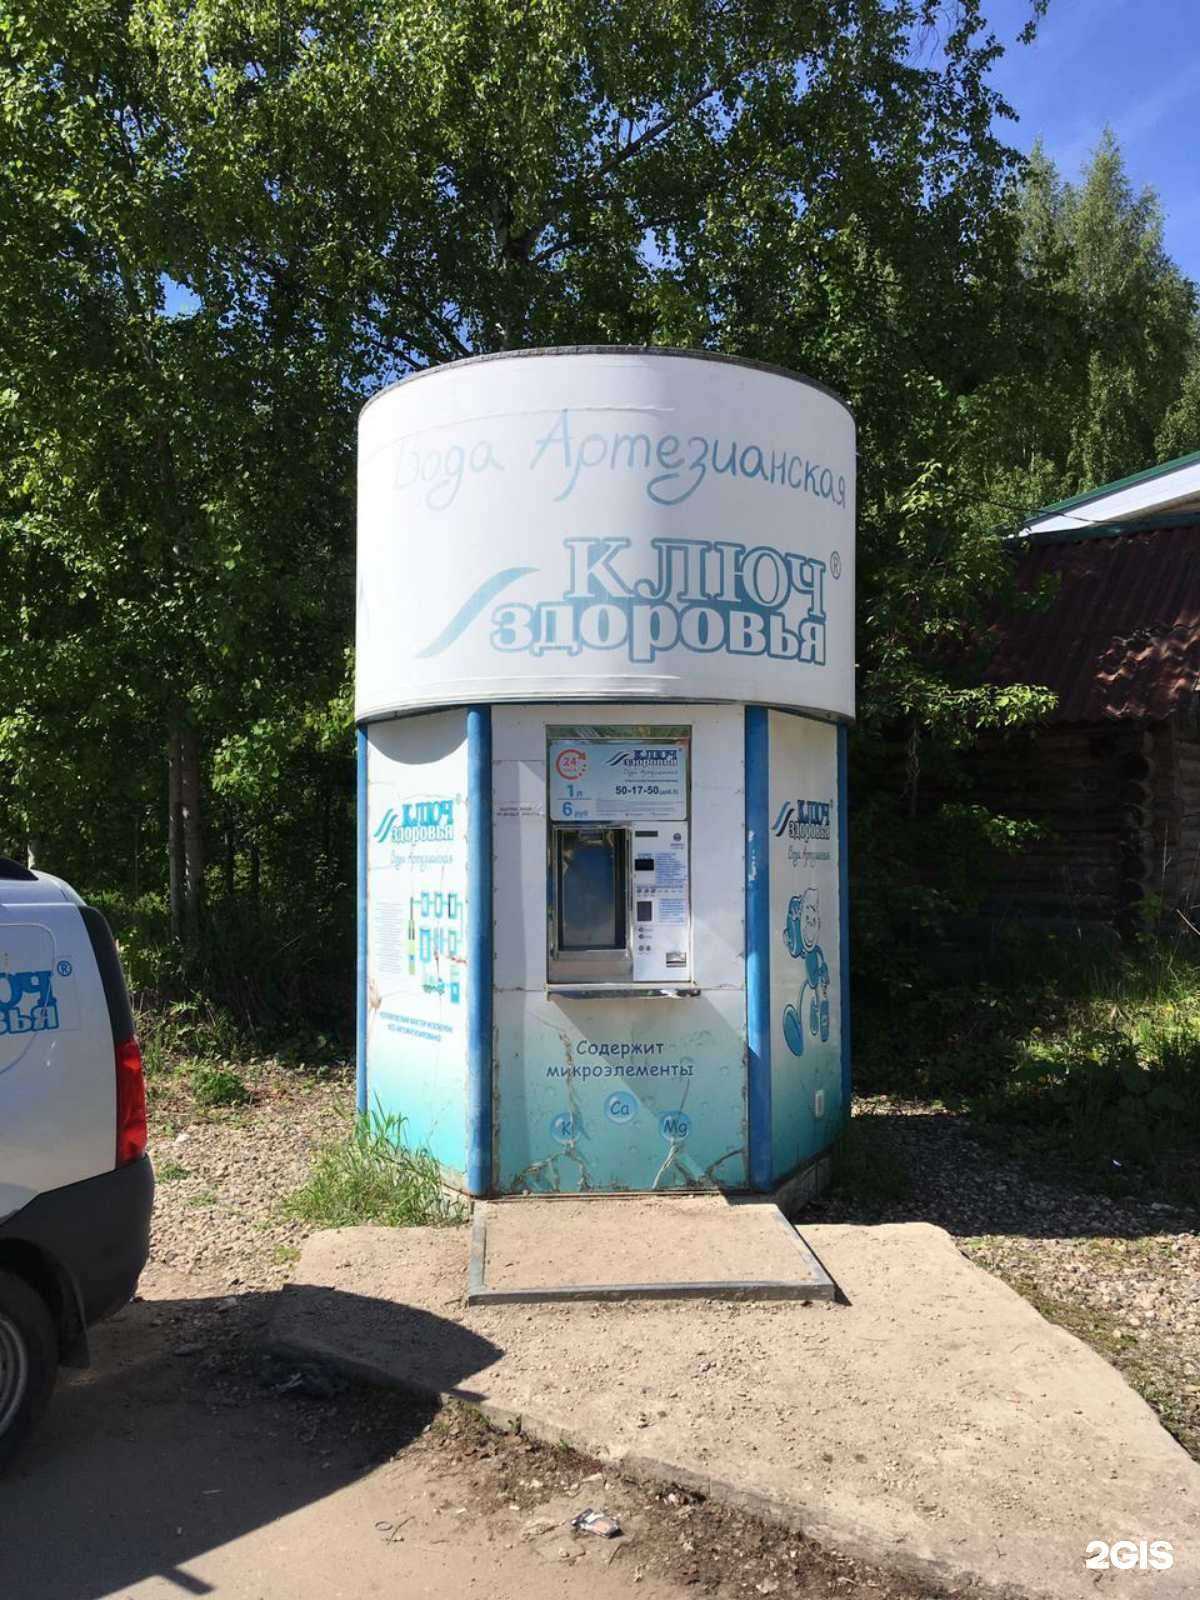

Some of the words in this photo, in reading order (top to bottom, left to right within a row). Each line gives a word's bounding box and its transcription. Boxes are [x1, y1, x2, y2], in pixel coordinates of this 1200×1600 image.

[529, 407, 847, 508] Артезианская
[615, 785, 659, 796] 50-17-50
[562, 801, 573, 816] 6
[576, 1040, 665, 1057] Содержит
[546, 1064, 694, 1080] микроэлементы
[609, 1100, 630, 1116] Ca
[663, 1119, 689, 1137] Mg
